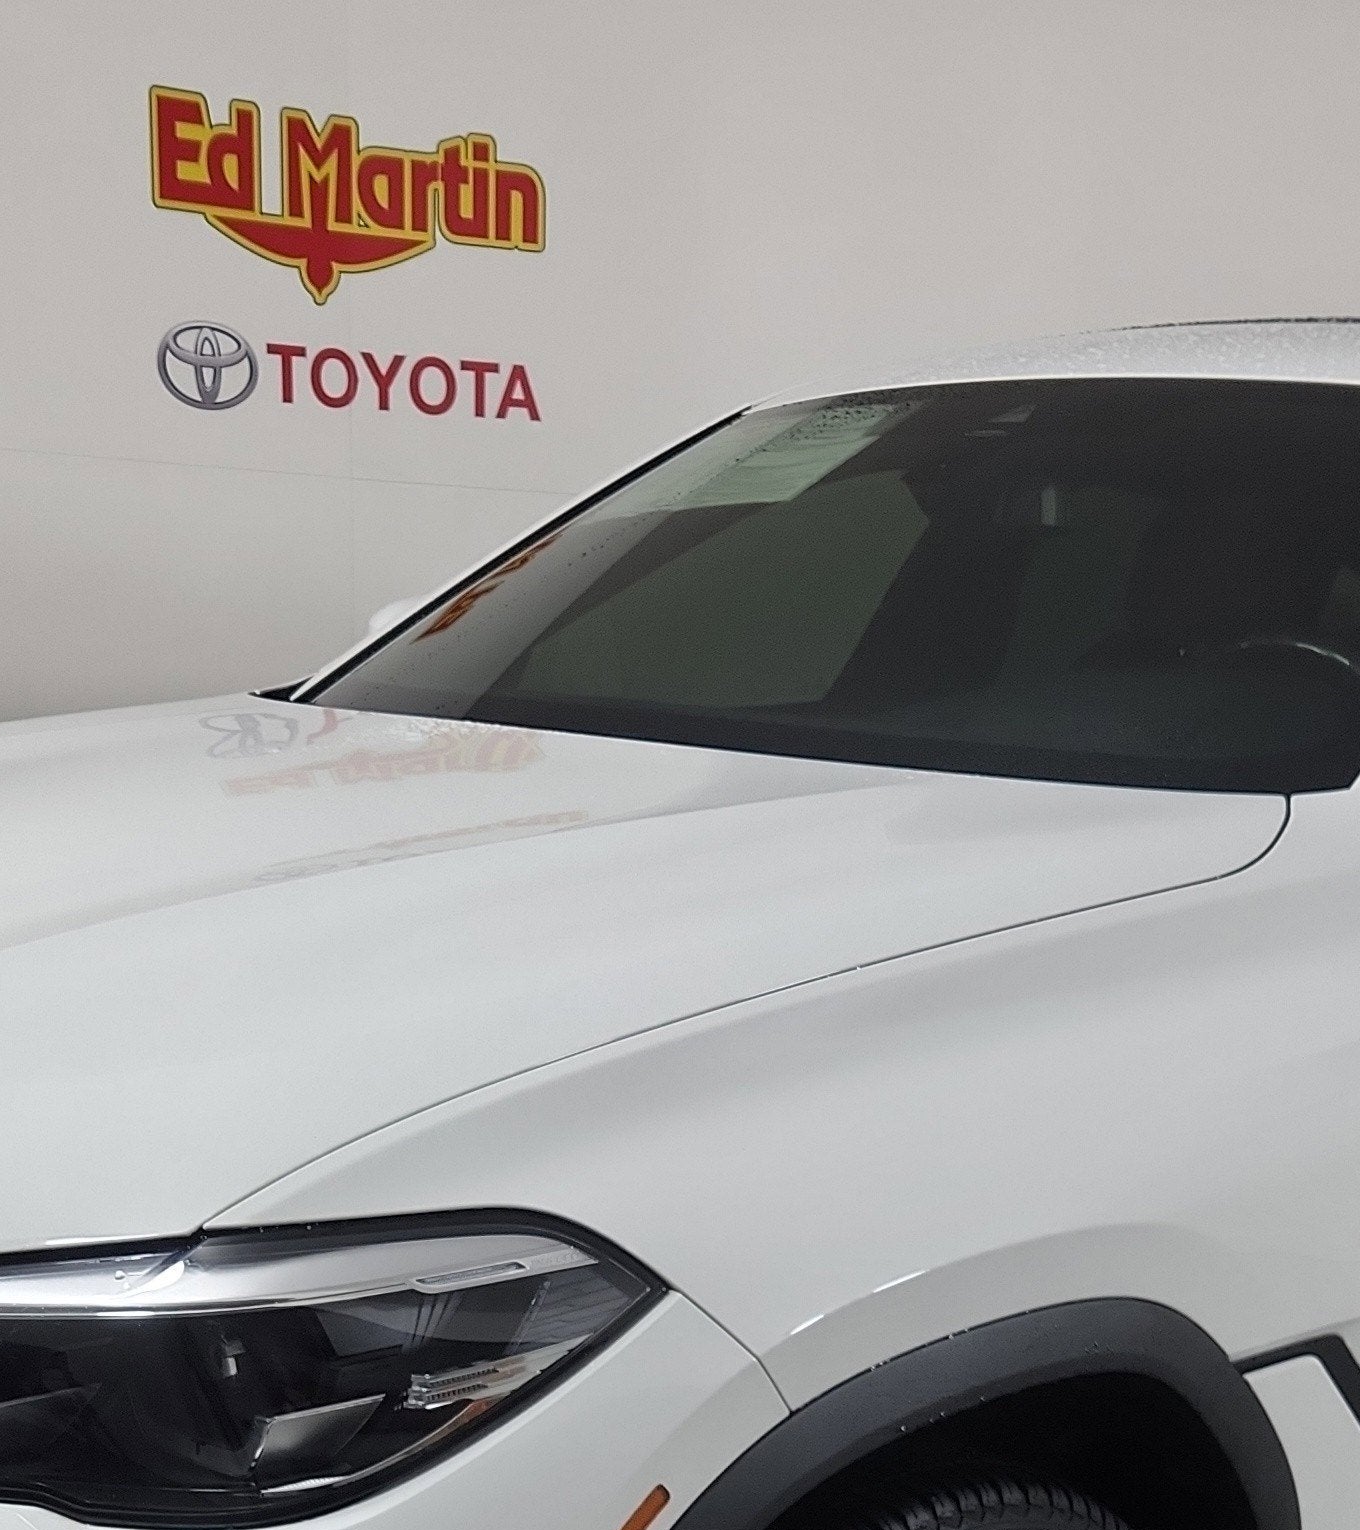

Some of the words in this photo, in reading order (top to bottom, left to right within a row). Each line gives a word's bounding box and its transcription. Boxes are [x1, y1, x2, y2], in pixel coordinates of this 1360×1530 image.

[152, 90, 258, 212] Ed
[283, 112, 543, 248] Martin
[265, 342, 542, 422] TOYOTA
